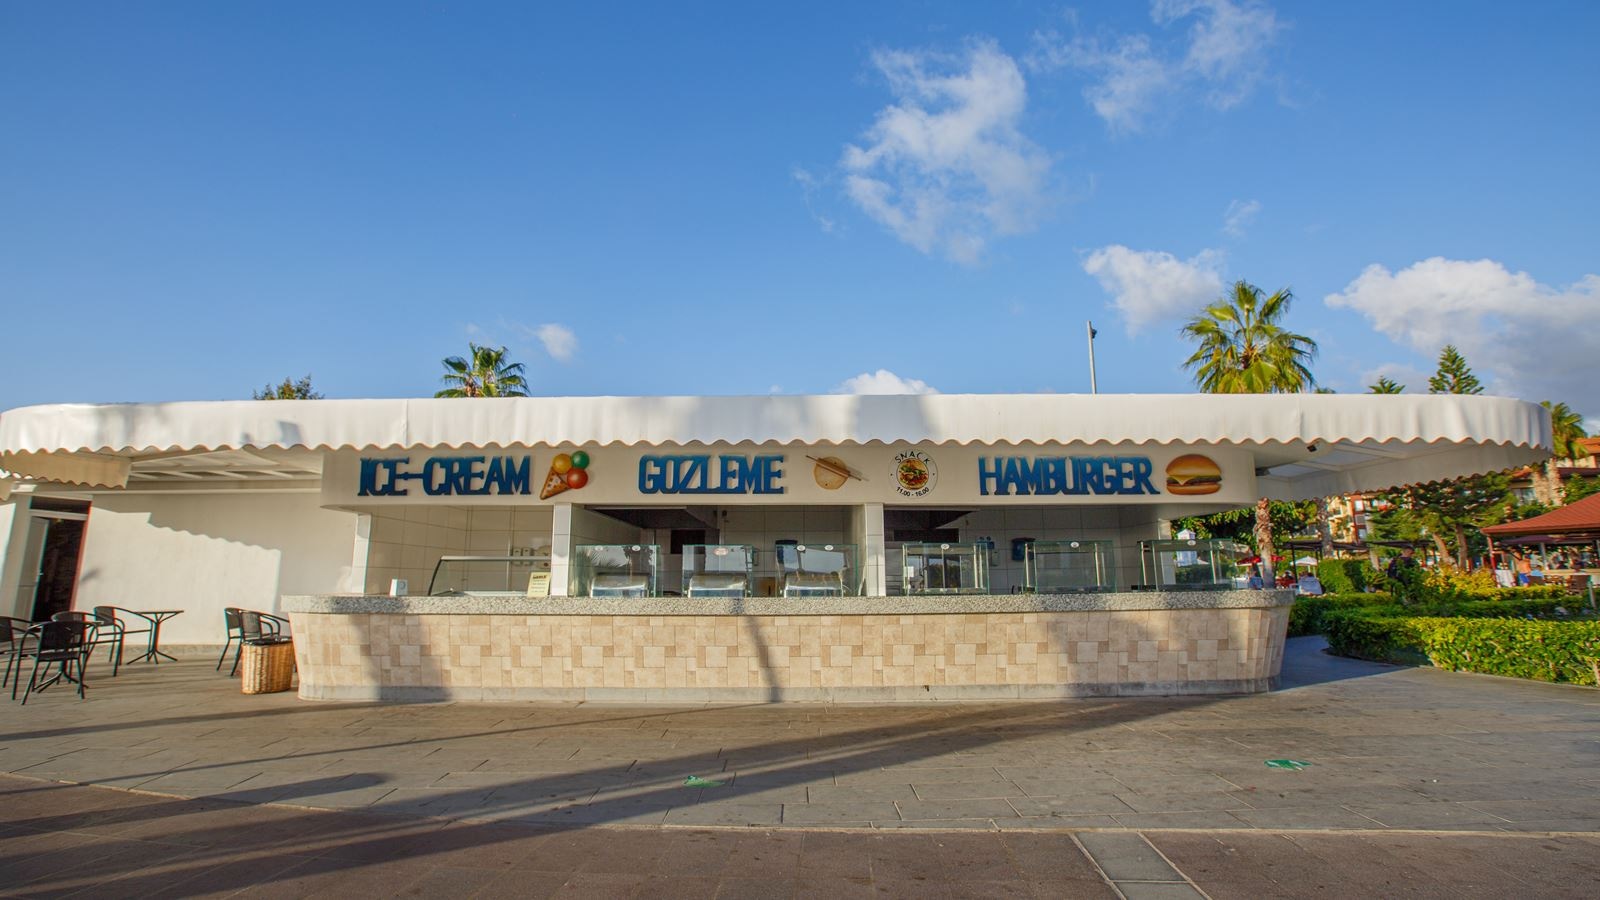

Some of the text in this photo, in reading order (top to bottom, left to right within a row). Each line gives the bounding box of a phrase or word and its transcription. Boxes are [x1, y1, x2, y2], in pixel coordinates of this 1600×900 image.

[357, 455, 531, 496] ICE-CREAM
[895, 451, 930, 464] SNACK
[978, 454, 1161, 496] HAMBURGER
